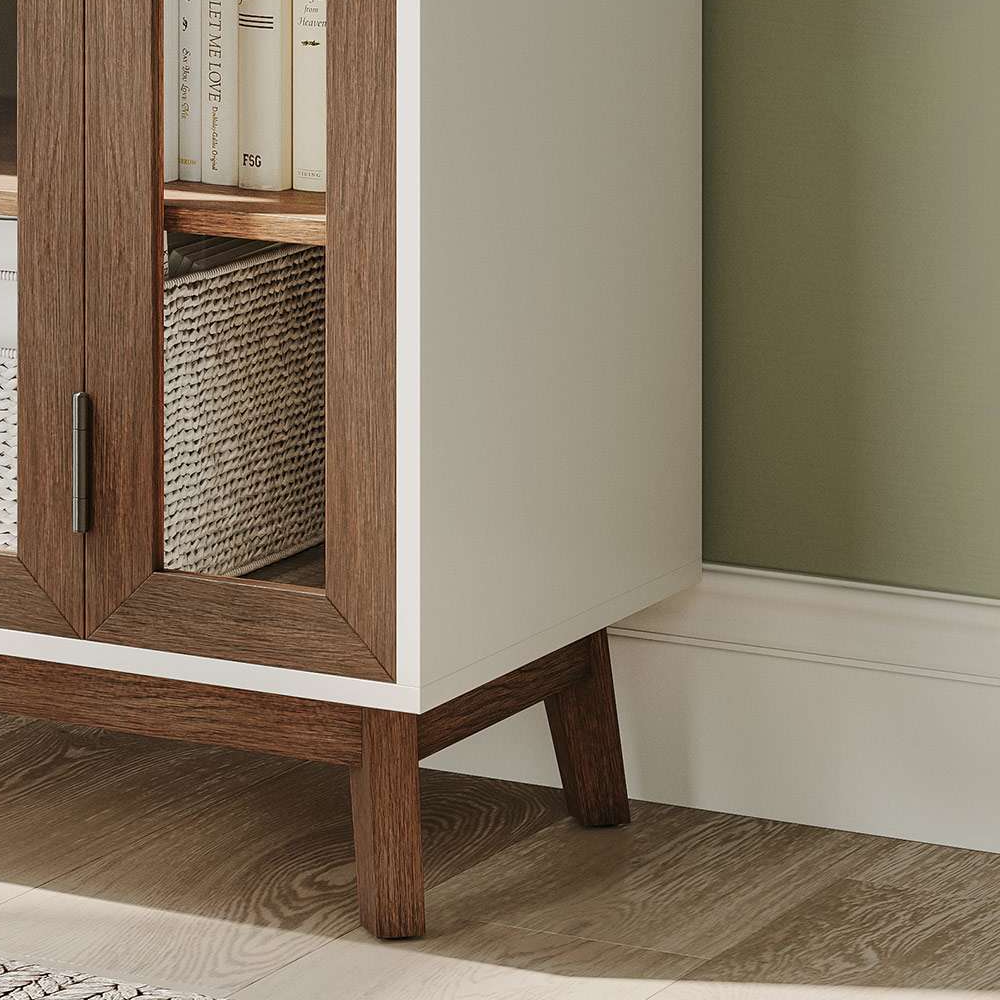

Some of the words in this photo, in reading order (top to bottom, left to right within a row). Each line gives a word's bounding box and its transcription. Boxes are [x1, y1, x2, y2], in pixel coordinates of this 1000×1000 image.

[208, 1, 222, 32] LET
[304, 5, 319, 13] from
[297, 16, 327, 28] Heaven
[208, 35, 222, 59] ME
[208, 62, 222, 103] LOVE
[242, 153, 262, 168] FSG
